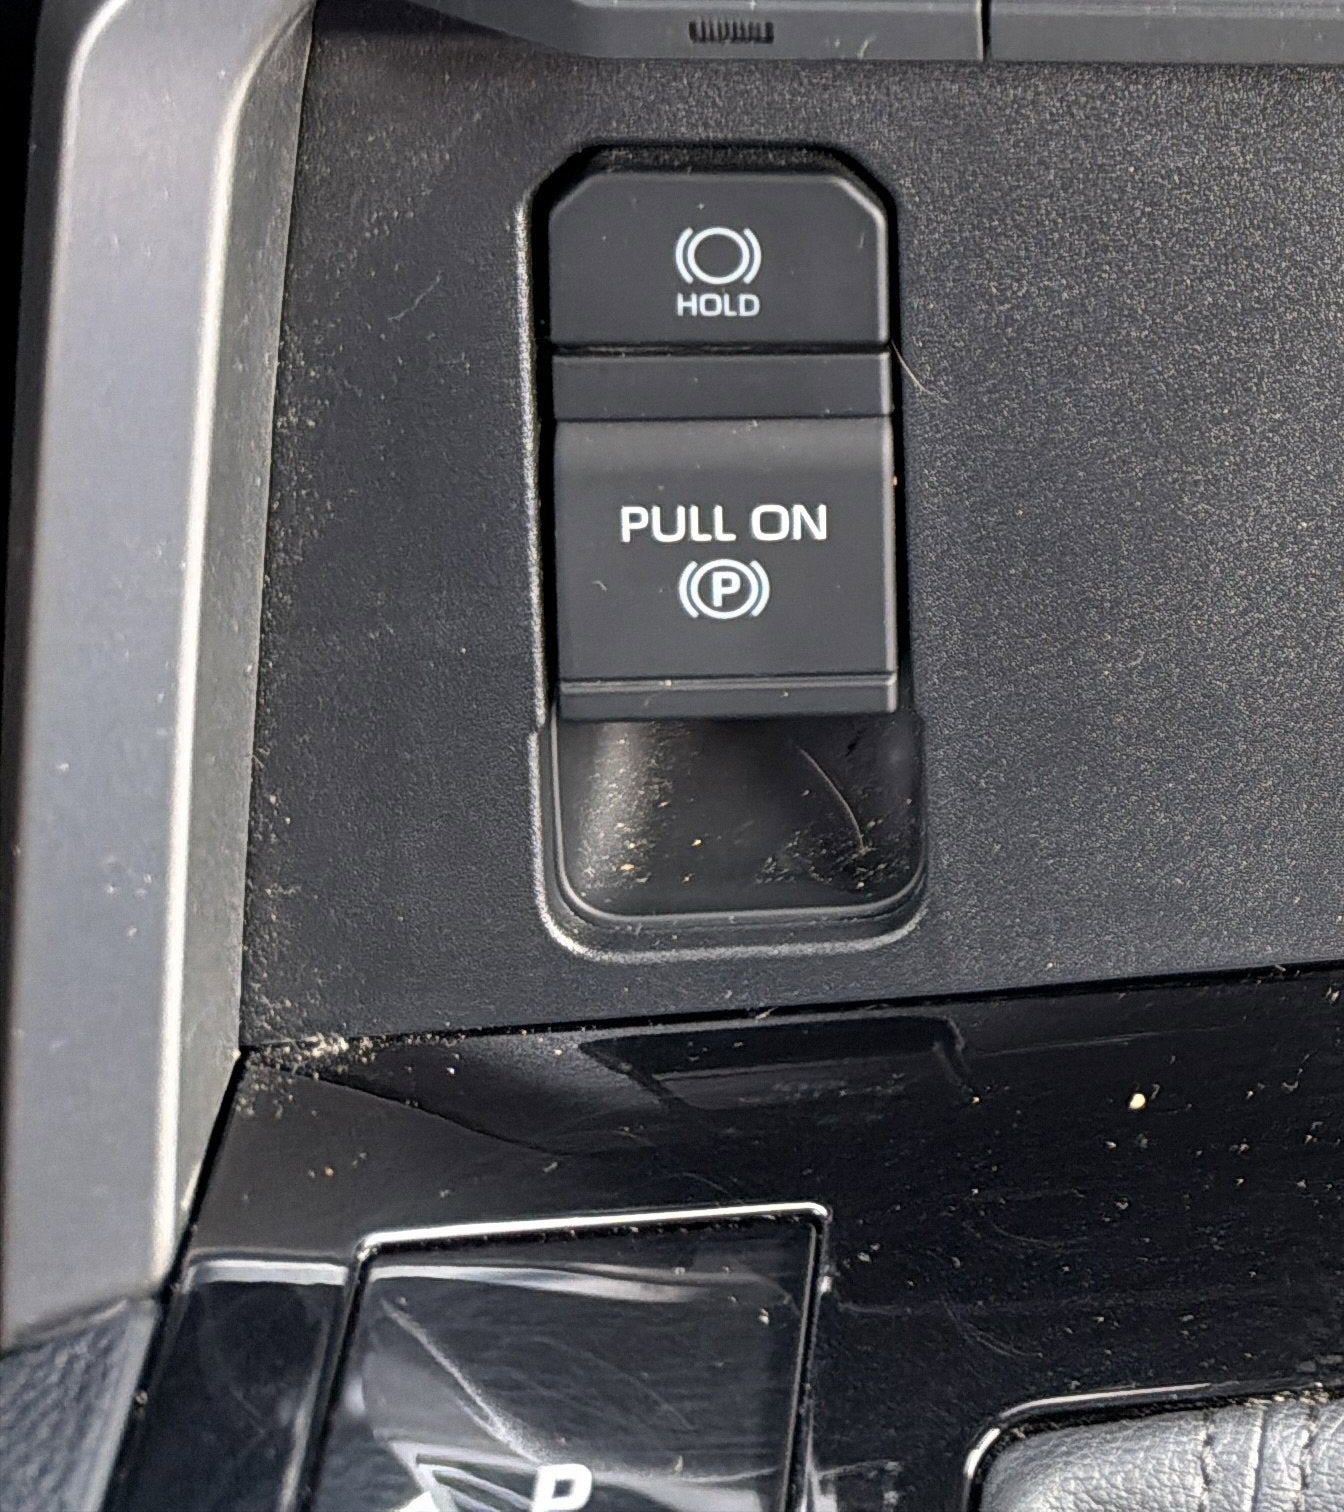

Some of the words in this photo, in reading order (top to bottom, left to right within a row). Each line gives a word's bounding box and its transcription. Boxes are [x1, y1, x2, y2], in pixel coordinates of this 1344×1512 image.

[676, 292, 761, 318] HOLD
[620, 504, 737, 543] PULL
[750, 503, 829, 542] ON
